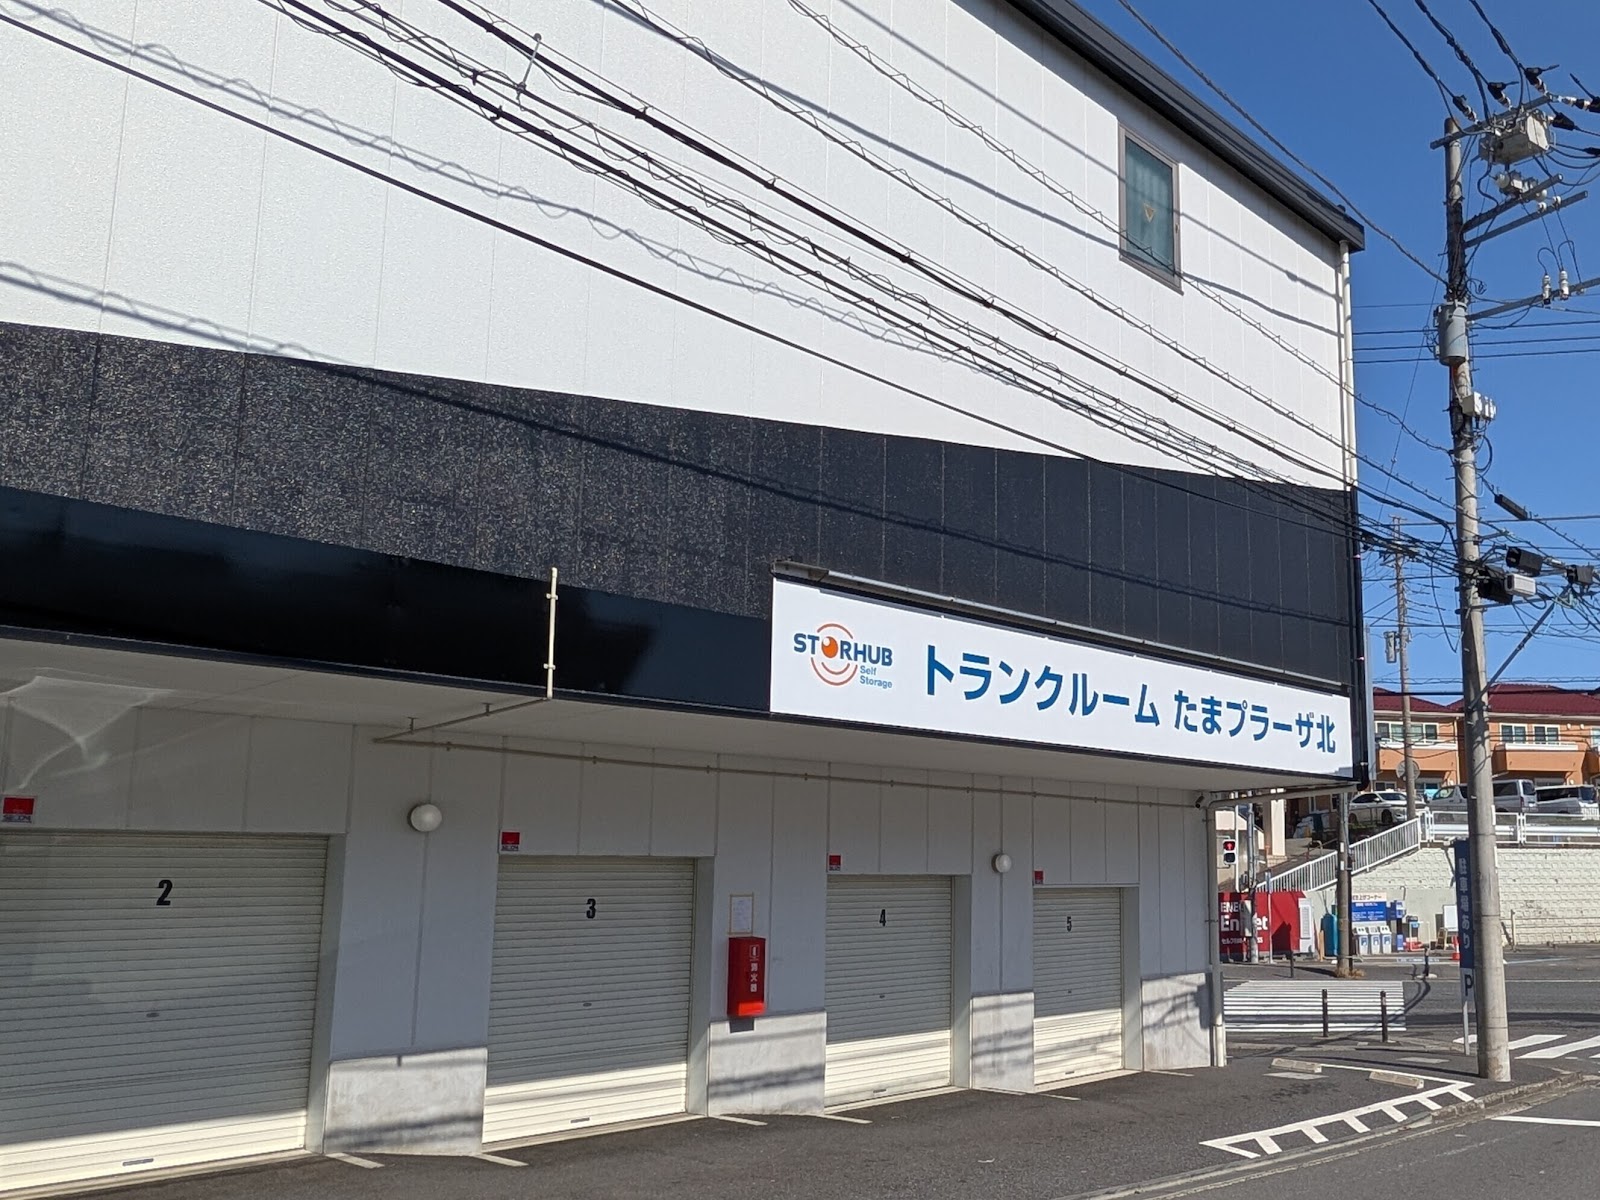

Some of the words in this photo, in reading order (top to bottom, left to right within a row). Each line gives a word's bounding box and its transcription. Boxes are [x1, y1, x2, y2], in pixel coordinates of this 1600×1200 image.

[793, 633, 893, 667] STORHUB
[860, 665, 877, 676] Self
[860, 675, 893, 689] Storage
[928, 645, 1160, 727] トランクルーム
[1175, 691, 1336, 753] たまプラーザ北
[156, 879, 173, 906] 2
[586, 898, 597, 919] 3
[879, 909, 887, 928] 4
[1066, 916, 1073, 933] 5
[1464, 974, 1474, 997] P
